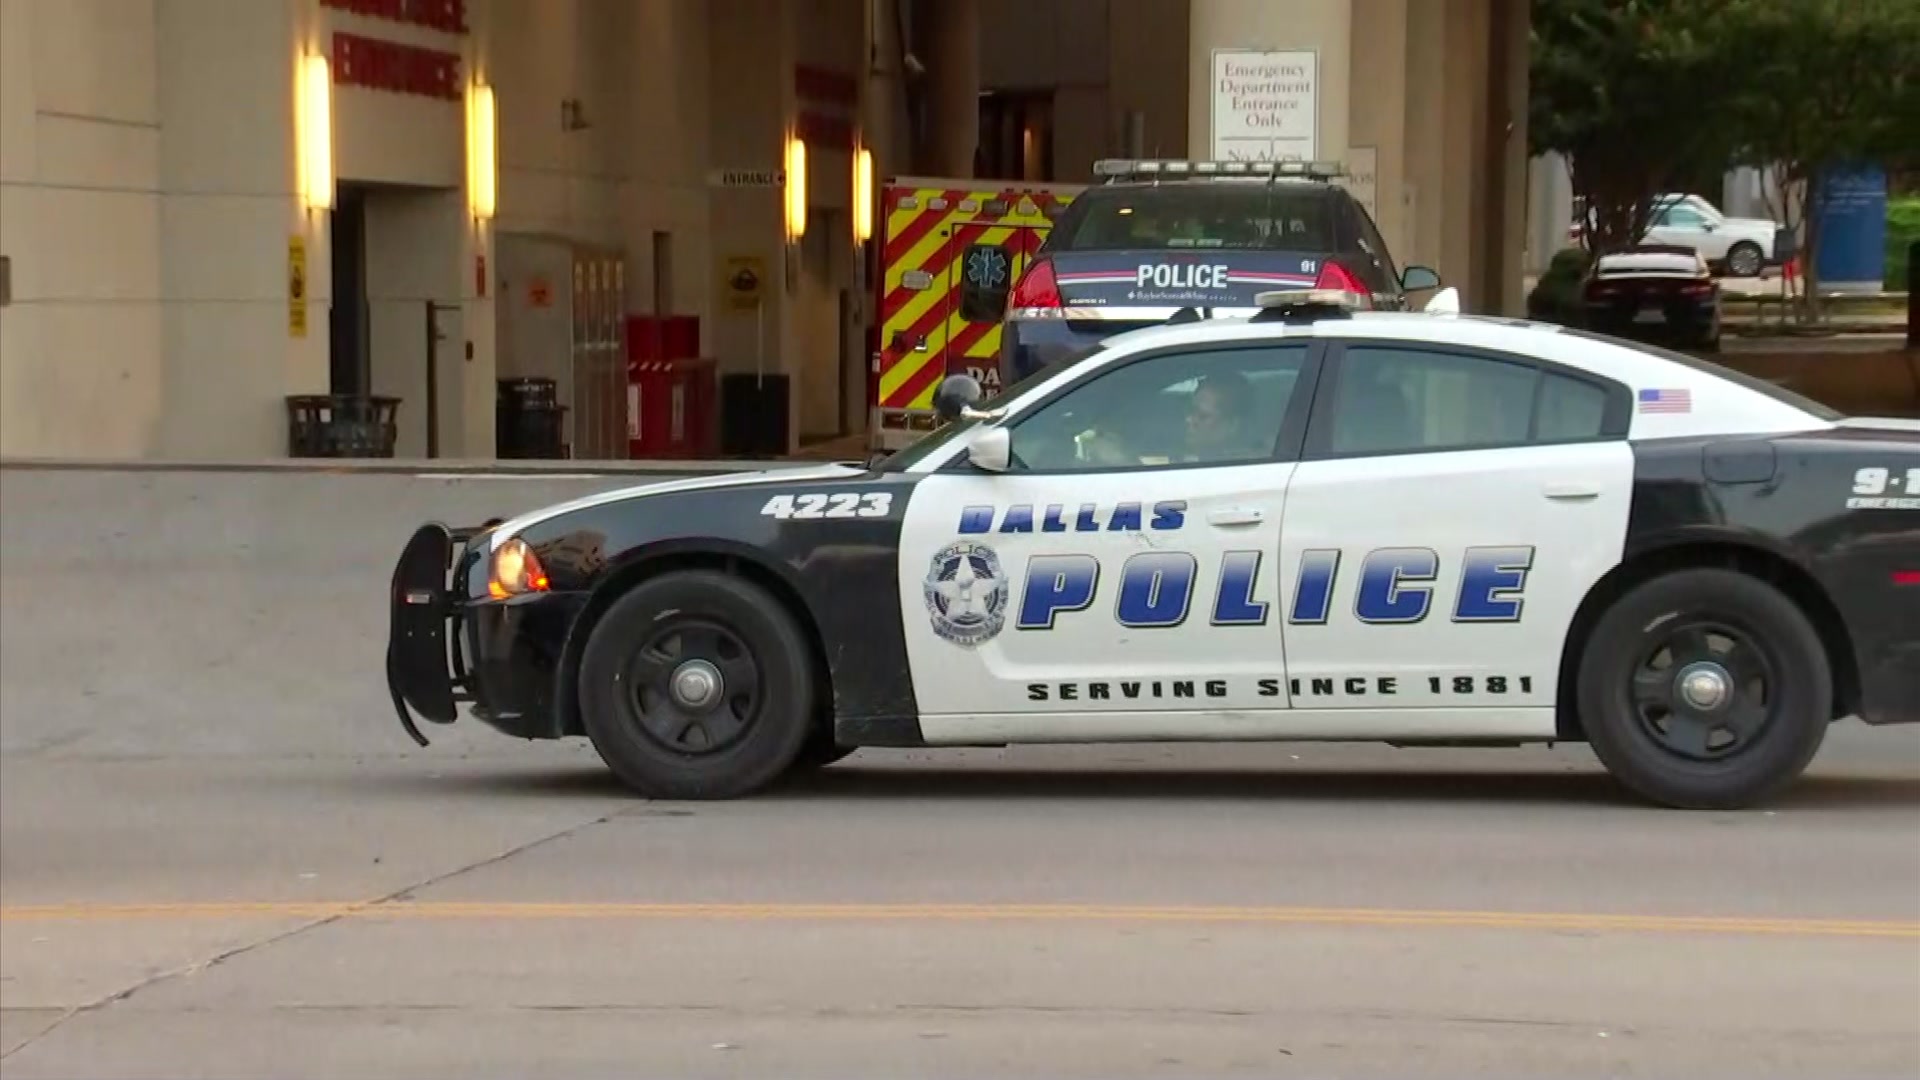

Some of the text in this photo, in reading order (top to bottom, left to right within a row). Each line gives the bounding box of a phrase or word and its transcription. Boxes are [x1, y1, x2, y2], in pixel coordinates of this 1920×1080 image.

[1225, 63, 1305, 78] Emergency
[1220, 80, 1310, 95] Department
[1232, 96, 1298, 110] Entrance
[1245, 113, 1283, 127] Only
[1137, 264, 1228, 288] POLICE
[761, 493, 893, 519] 4223
[958, 500, 1188, 534] DALLAS
[1015, 546, 1536, 630] POLICE
[1027, 676, 1533, 701] SERVING SINCE 1881
